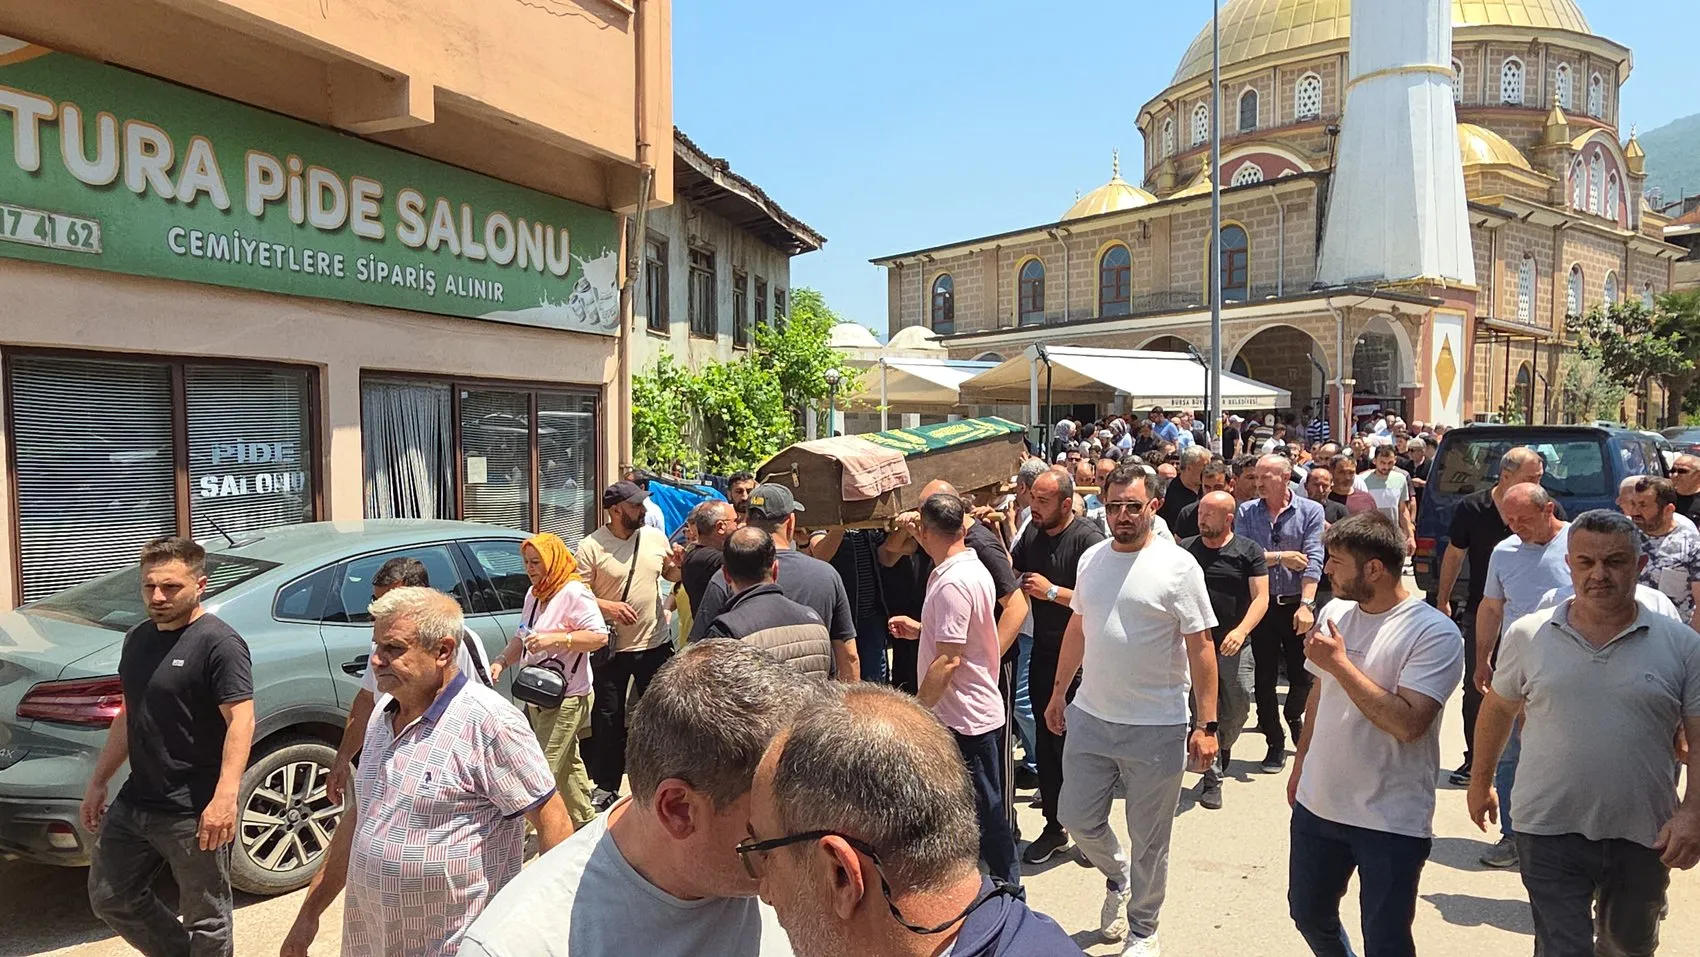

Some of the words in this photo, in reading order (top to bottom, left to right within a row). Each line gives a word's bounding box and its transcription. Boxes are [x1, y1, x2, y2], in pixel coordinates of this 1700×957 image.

[0, 86, 230, 209] TURA
[396, 188, 570, 276] SALONU
[67, 221, 93, 248] 62
[168, 227, 345, 276] CEMİYETLERE
[356, 254, 436, 296] SİPARİŞ
[445, 275, 503, 302] ALINIR
